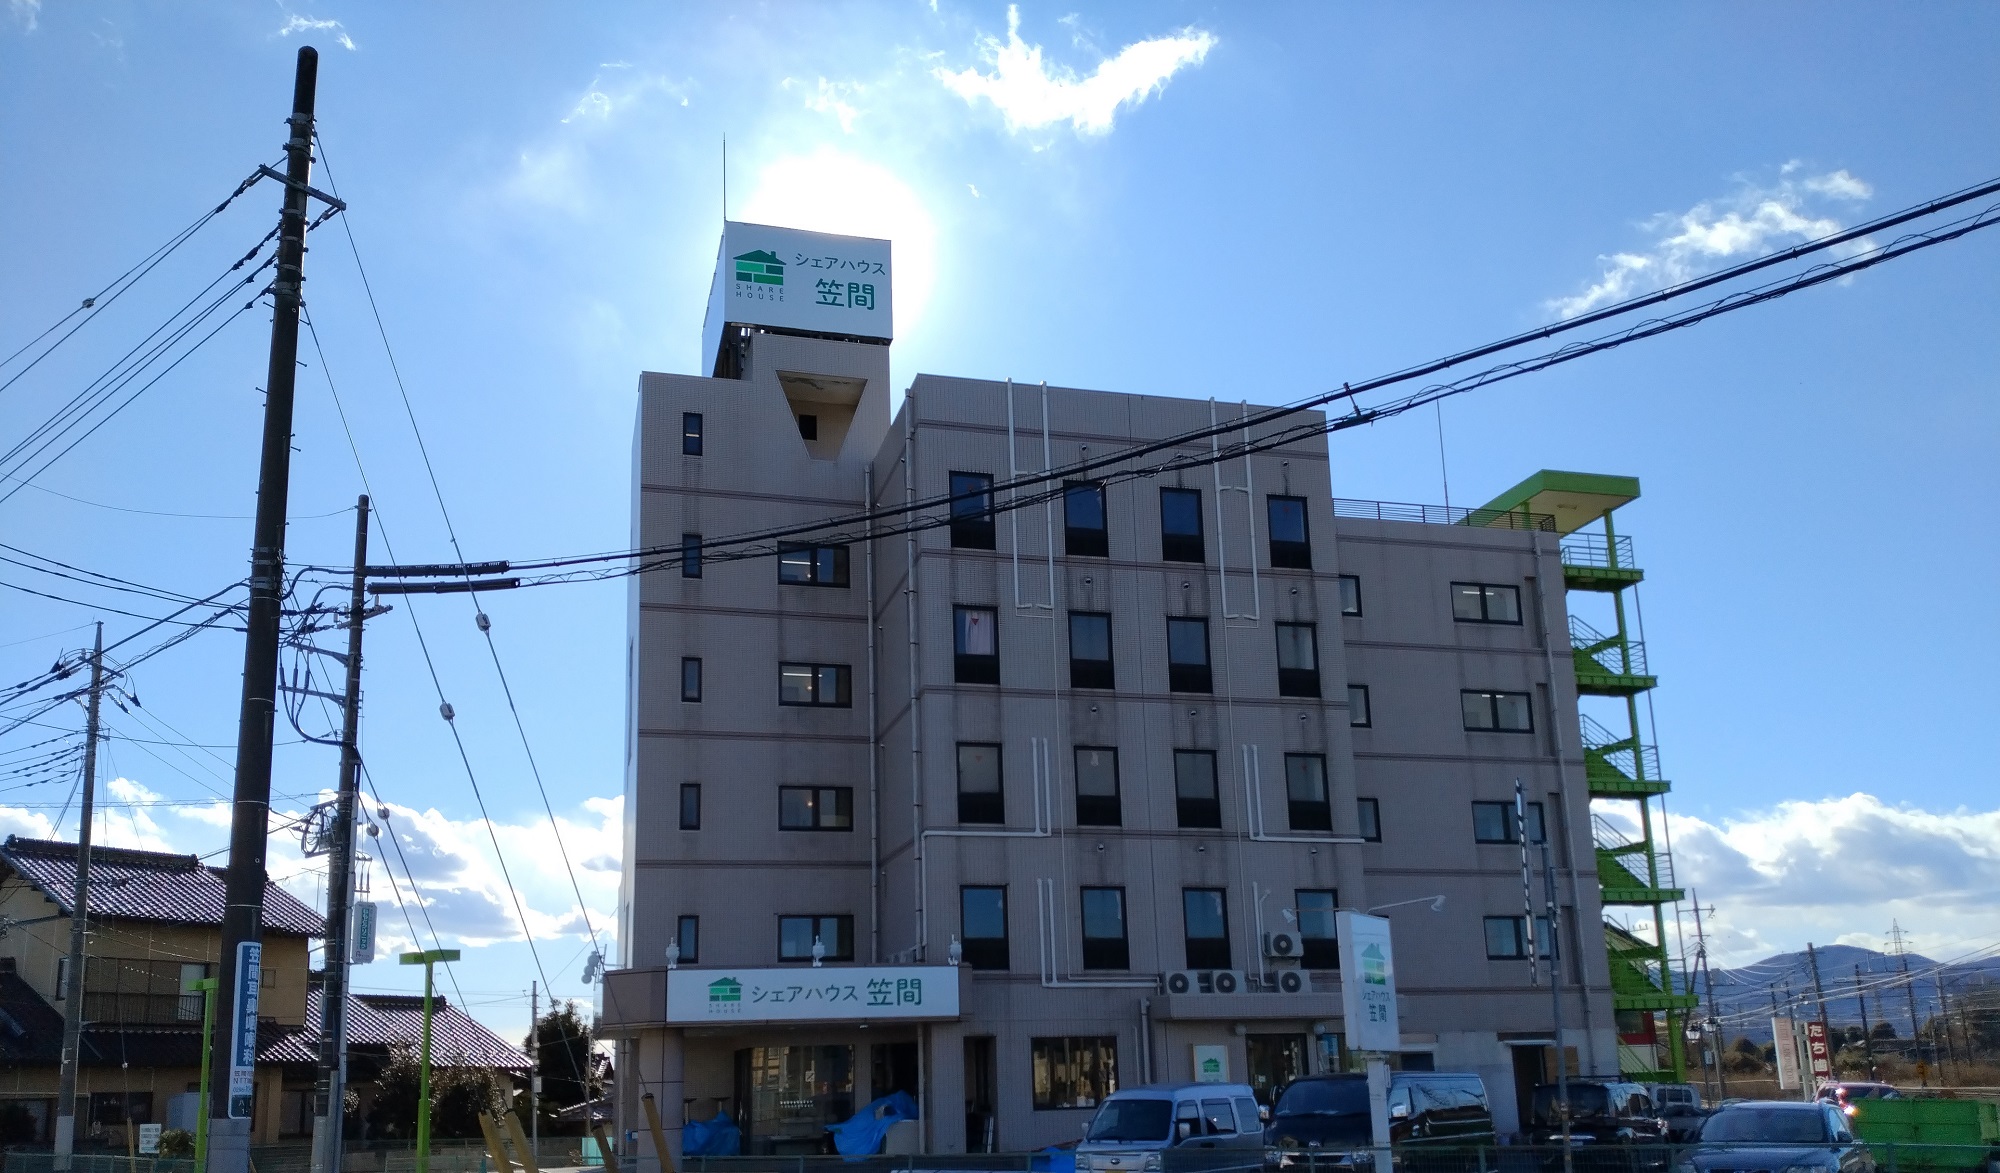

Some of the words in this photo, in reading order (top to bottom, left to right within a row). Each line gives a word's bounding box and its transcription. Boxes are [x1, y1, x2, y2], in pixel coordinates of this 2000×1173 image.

[795, 253, 886, 276] シェアハウス
[735, 283, 784, 294] SHARE
[735, 291, 784, 302] HOUSE
[815, 278, 875, 311] 笠間
[751, 984, 859, 1004] シェアハウス
[866, 978, 922, 1006] 笠間
